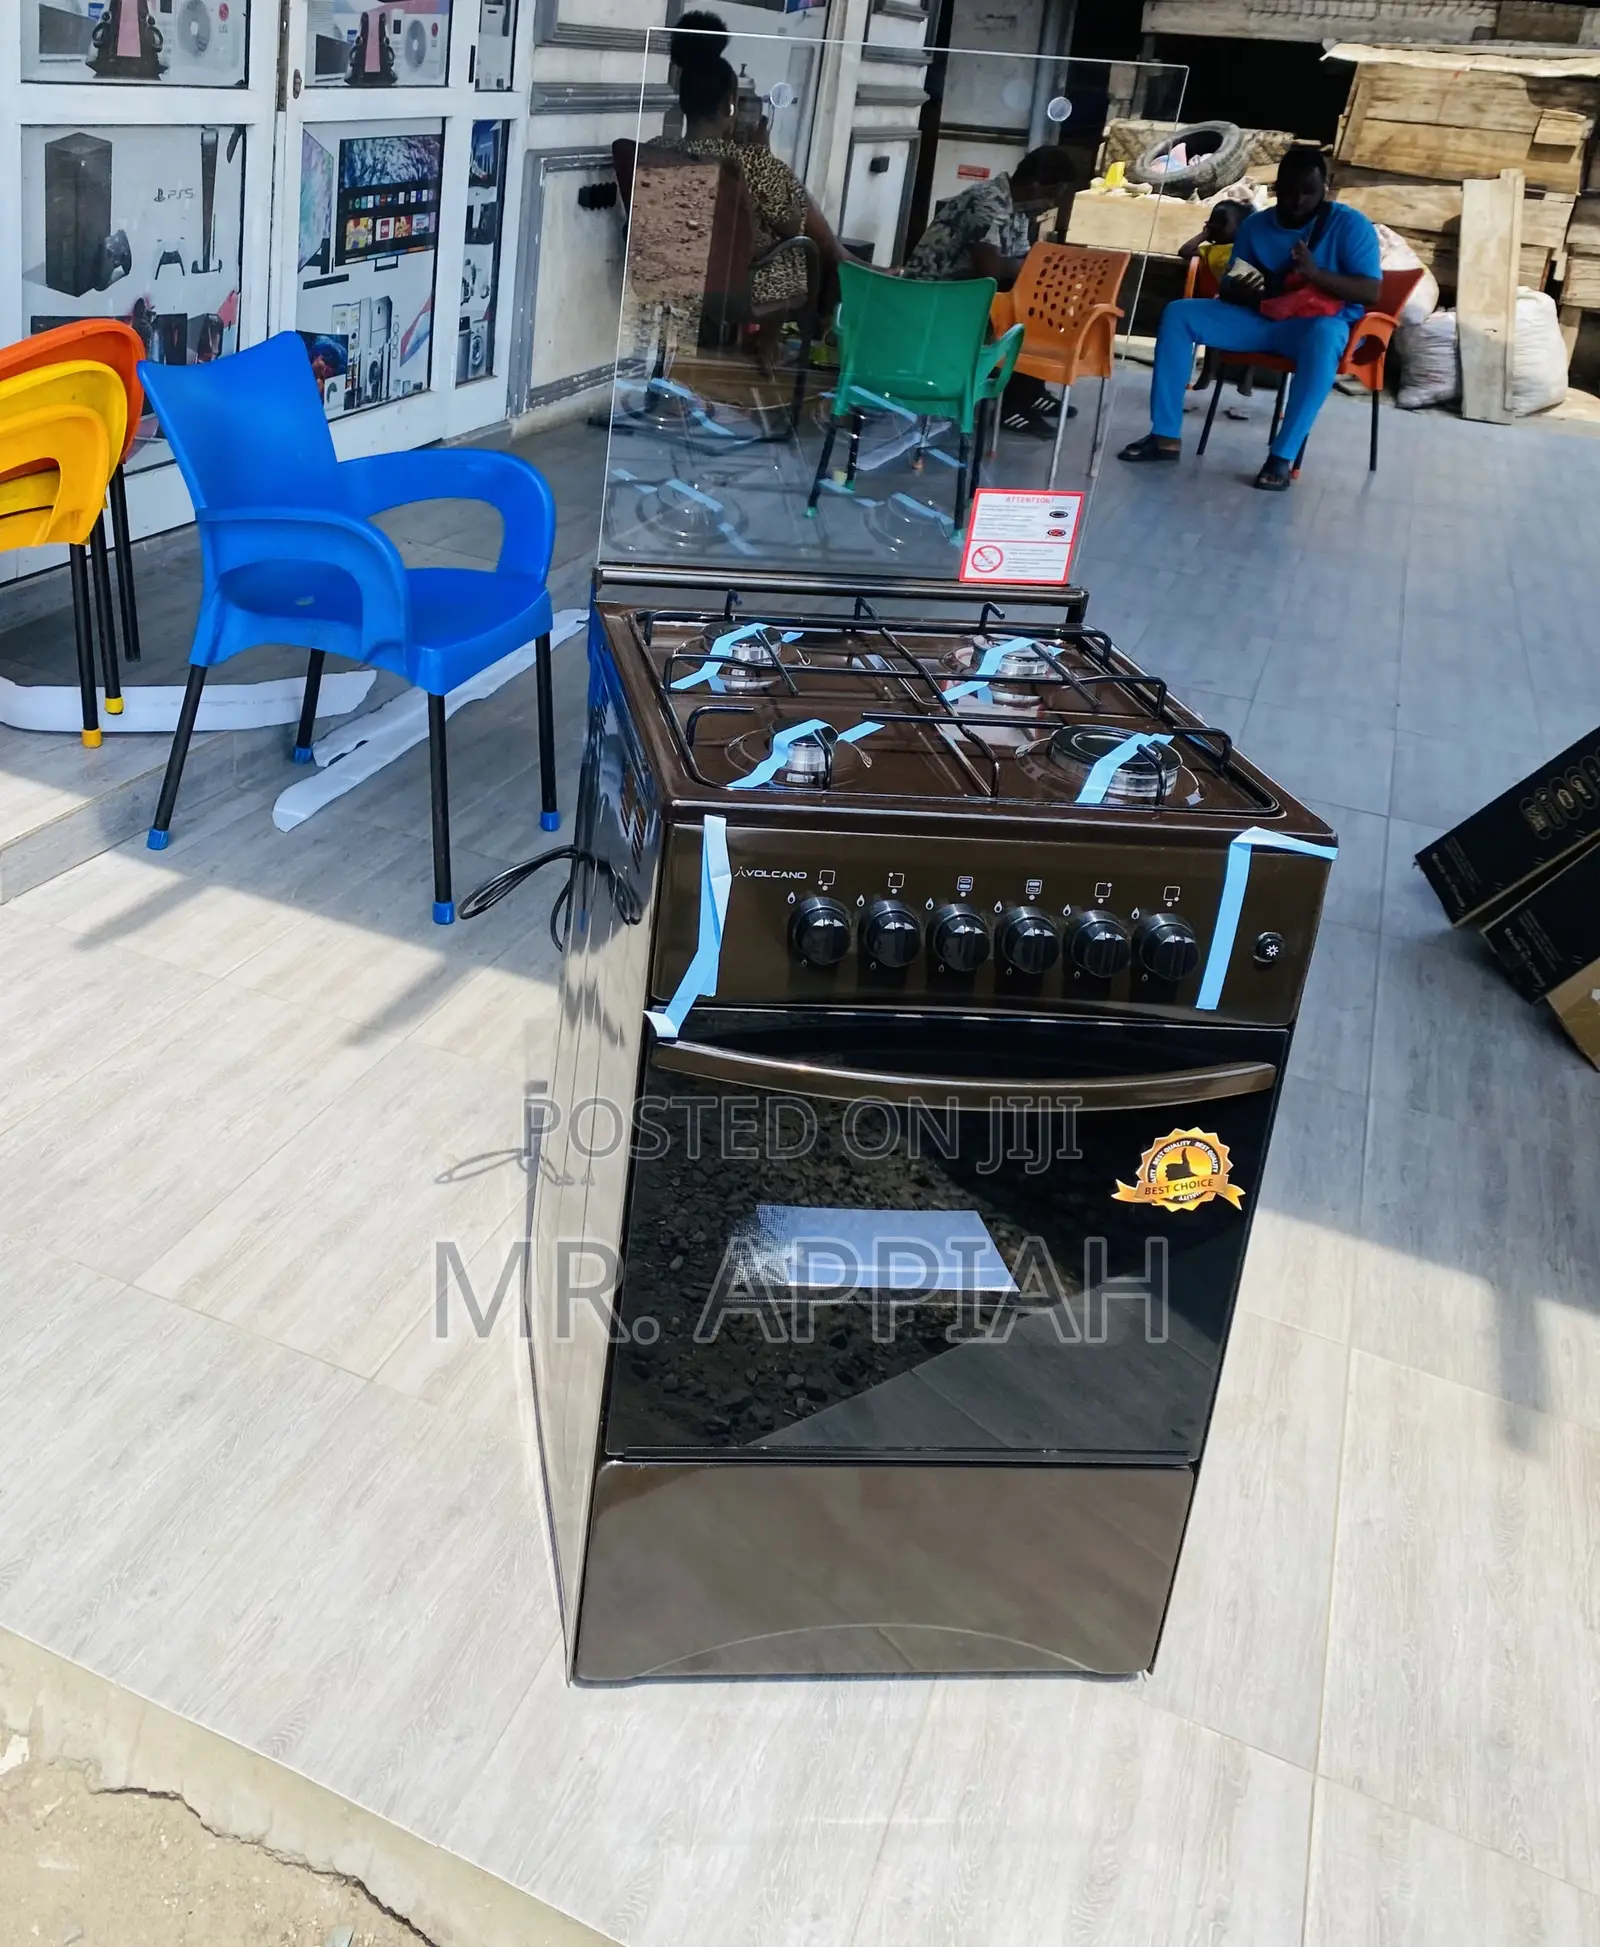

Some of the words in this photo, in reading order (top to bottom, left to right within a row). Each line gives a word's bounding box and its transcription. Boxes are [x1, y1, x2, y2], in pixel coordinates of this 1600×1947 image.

[167, 188, 194, 200] PS5
[746, 869, 807, 879] VOLCANO
[1153, 1152, 1165, 1165] BEST
[1163, 1140, 1191, 1152] QUALITY
[1194, 1141, 1210, 1152] BEST
[1207, 1149, 1218, 1172] QUALITY
[1144, 1186, 1170, 1195] BEST
[1173, 1179, 1214, 1191] CHOICE
